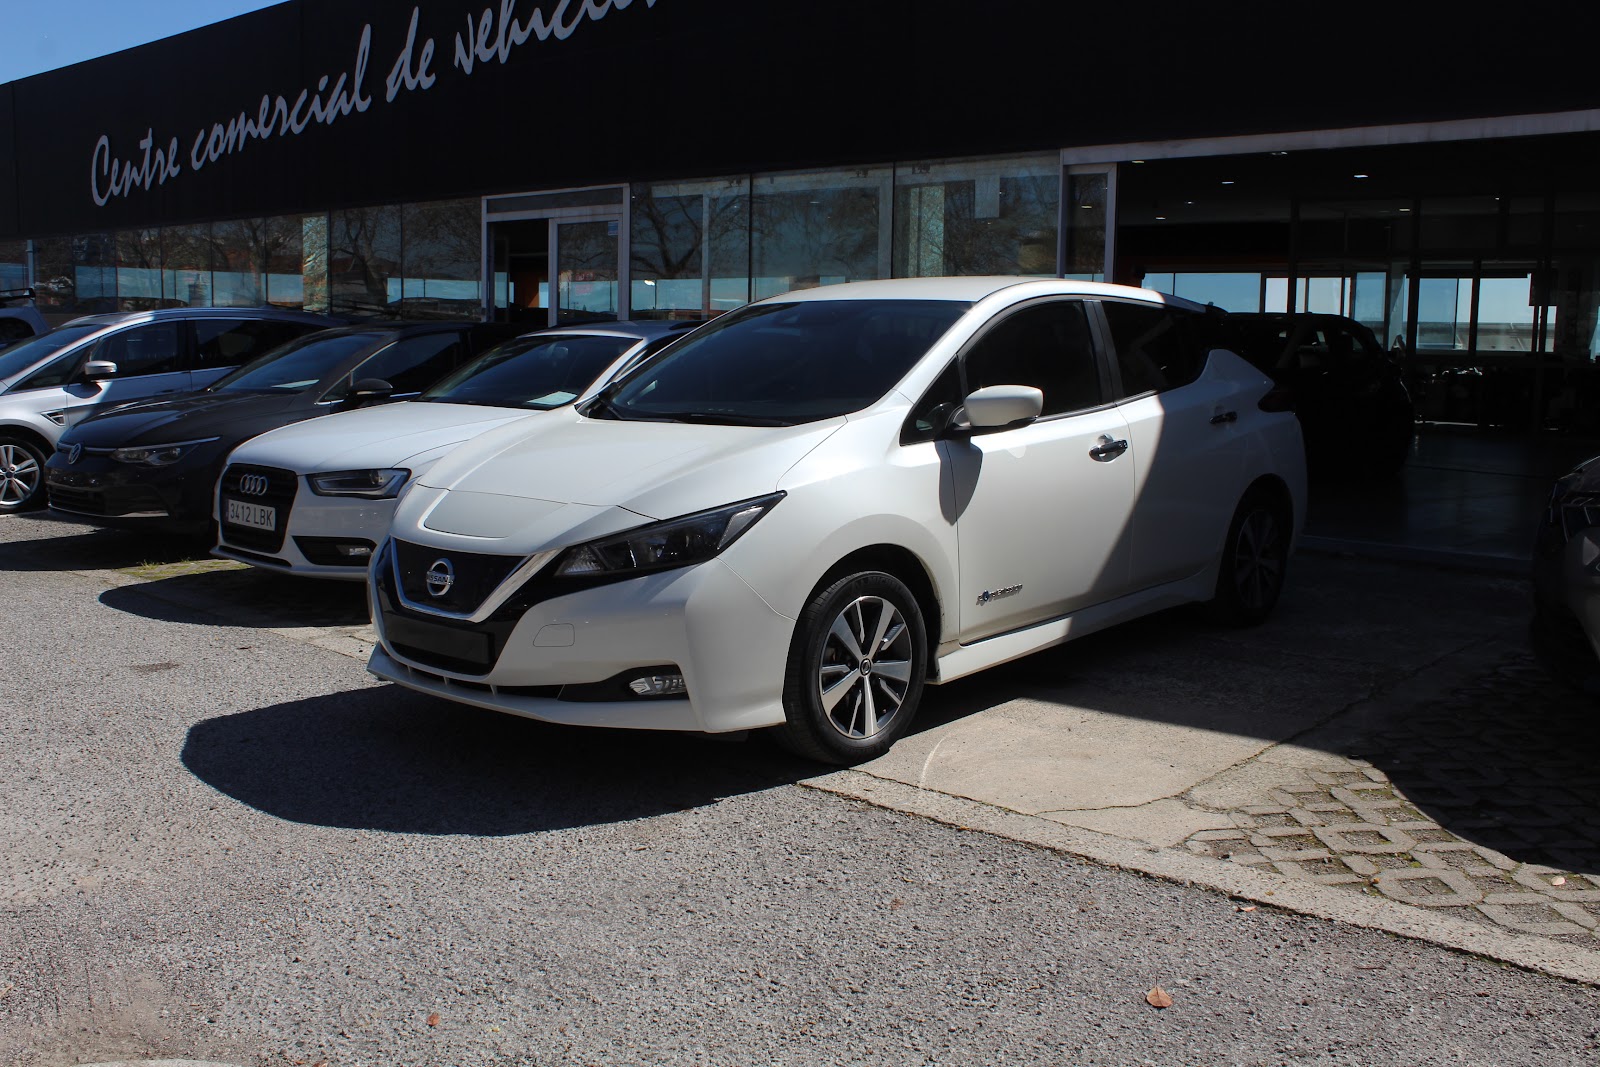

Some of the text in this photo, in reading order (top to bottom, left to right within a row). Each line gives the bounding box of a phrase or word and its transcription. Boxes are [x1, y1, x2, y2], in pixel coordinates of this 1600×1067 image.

[91, 0, 657, 206] Centre comercial de vehic
[230, 503, 273, 527] 3412 LBK
